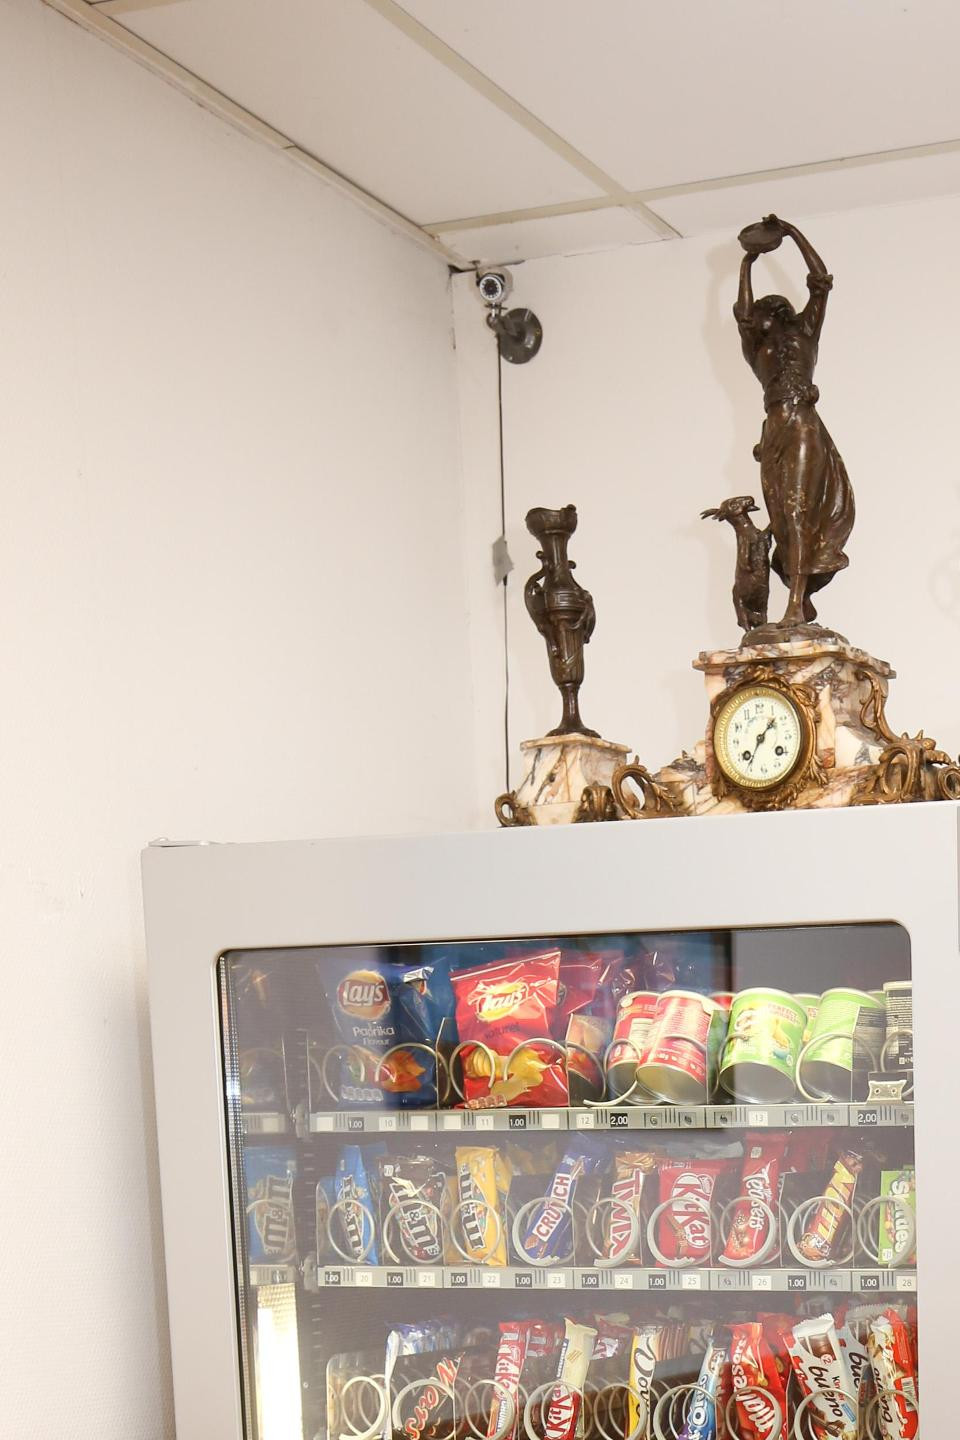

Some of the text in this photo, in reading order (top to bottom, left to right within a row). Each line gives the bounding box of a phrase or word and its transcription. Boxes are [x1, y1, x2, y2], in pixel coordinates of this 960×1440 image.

[343, 981, 385, 1006] Lay's
[349, 1120, 363, 1128] 1.00
[510, 1118, 525, 1127] 1.00
[536, 1173, 571, 1239] CRUNCH
[516, 1276, 530, 1284] 1.00
[582, 1277, 597, 1285] 1.00
[620, 1277, 629, 1285] 24
[649, 1278, 664, 1286] 1.00
[758, 1278, 767, 1286] 26
[788, 1279, 804, 1287] 1.00
[861, 1278, 877, 1287] 1.00
[902, 1278, 912, 1286] 28
